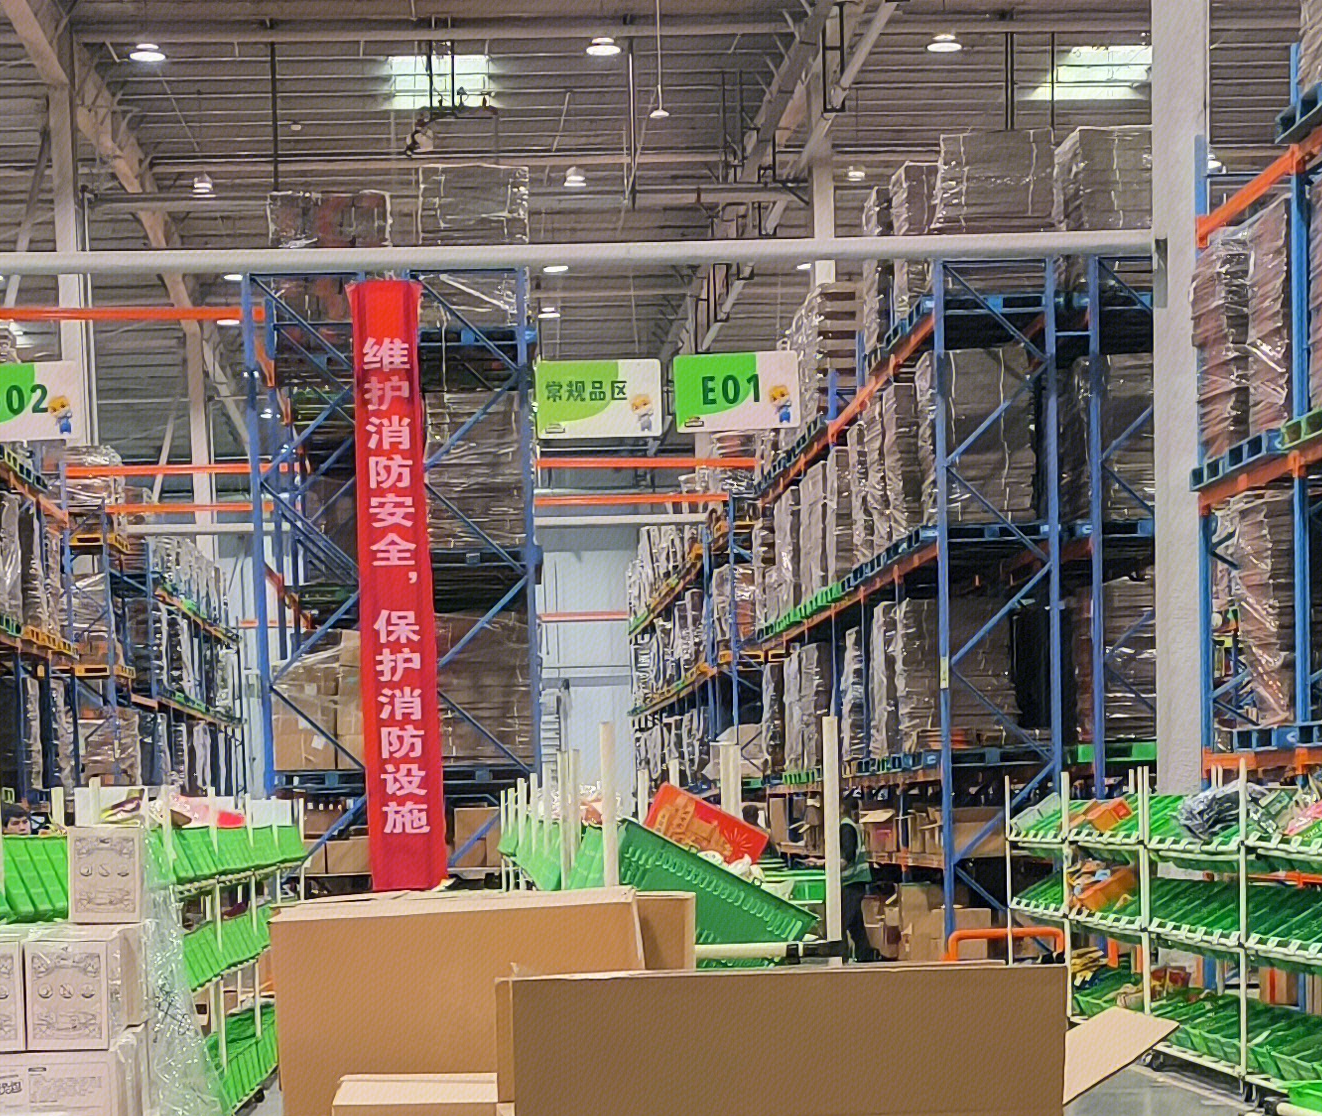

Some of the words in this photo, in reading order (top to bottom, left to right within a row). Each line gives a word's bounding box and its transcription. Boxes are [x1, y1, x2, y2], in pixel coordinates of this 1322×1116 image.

[545, 380, 628, 402] 常规品区
[701, 373, 761, 406] E01
